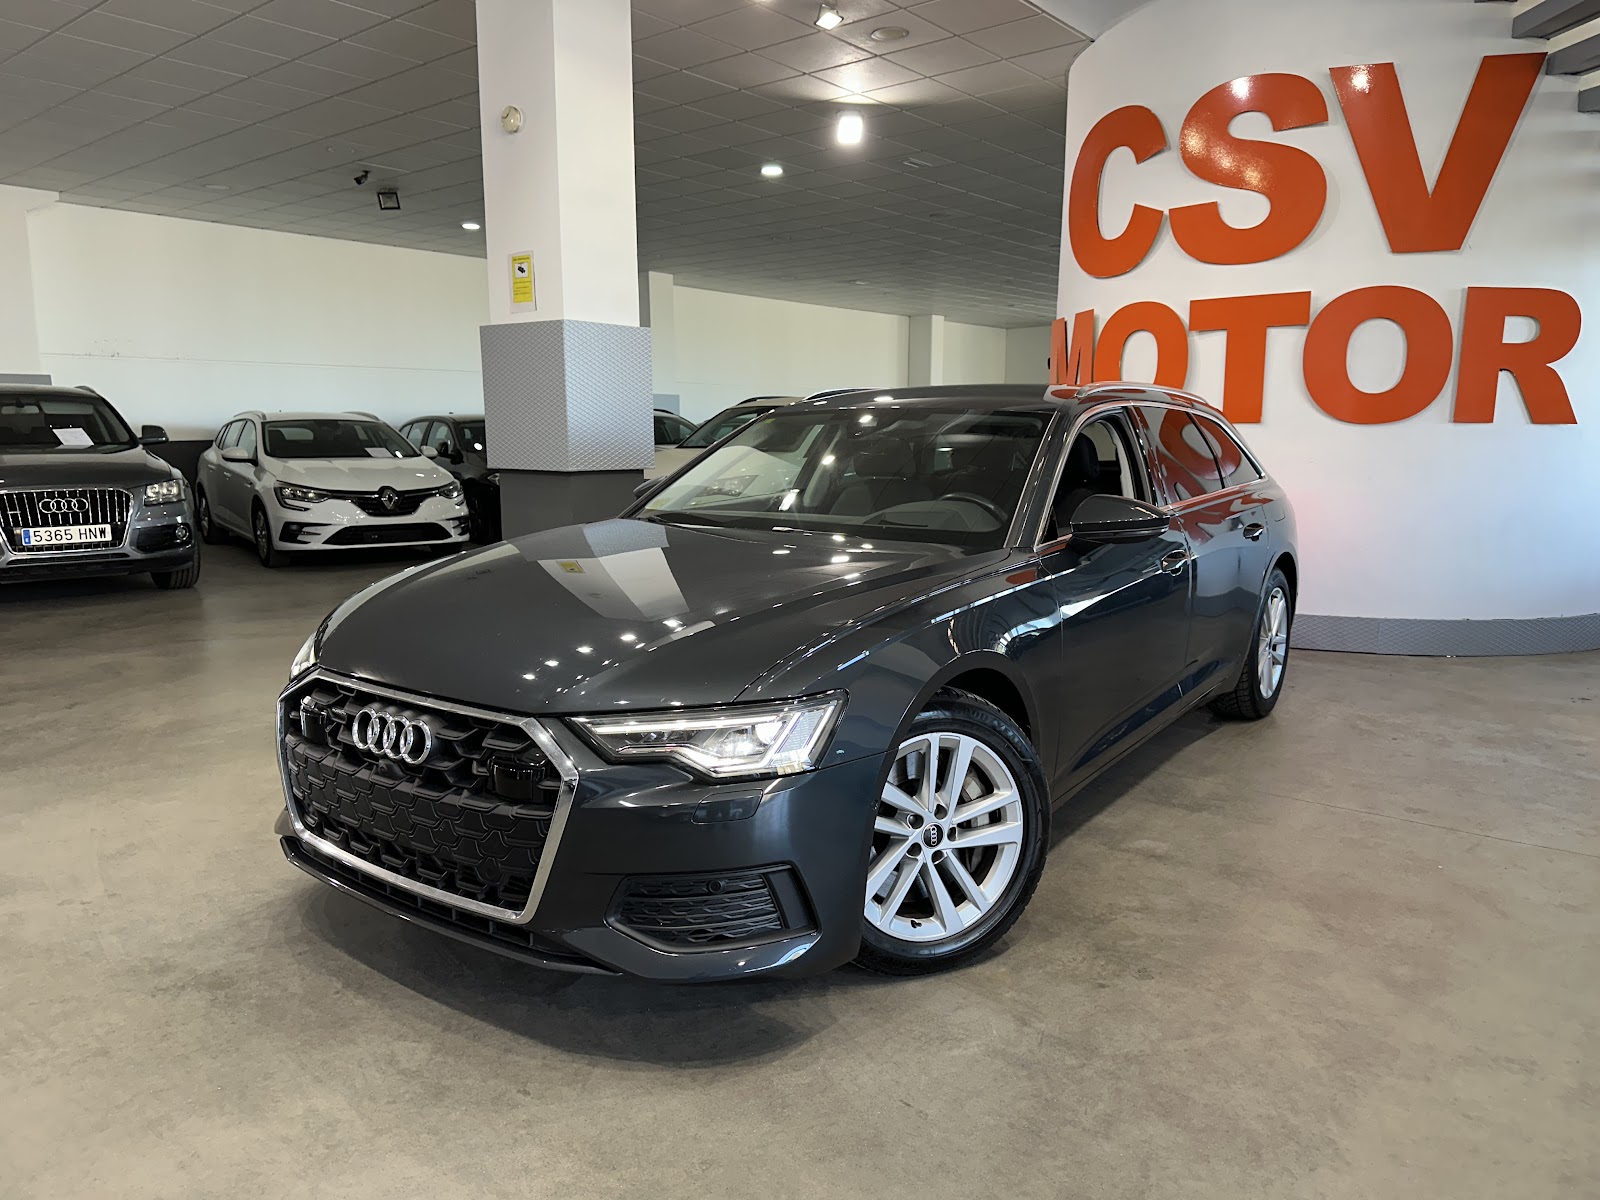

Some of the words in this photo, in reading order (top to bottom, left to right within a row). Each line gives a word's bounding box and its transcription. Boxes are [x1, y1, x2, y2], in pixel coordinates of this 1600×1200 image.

[1068, 52, 1548, 278] CSV
[1050, 285, 1582, 425] MOTOR
[33, 529, 73, 543] 5365
[78, 526, 106, 540] HNW
